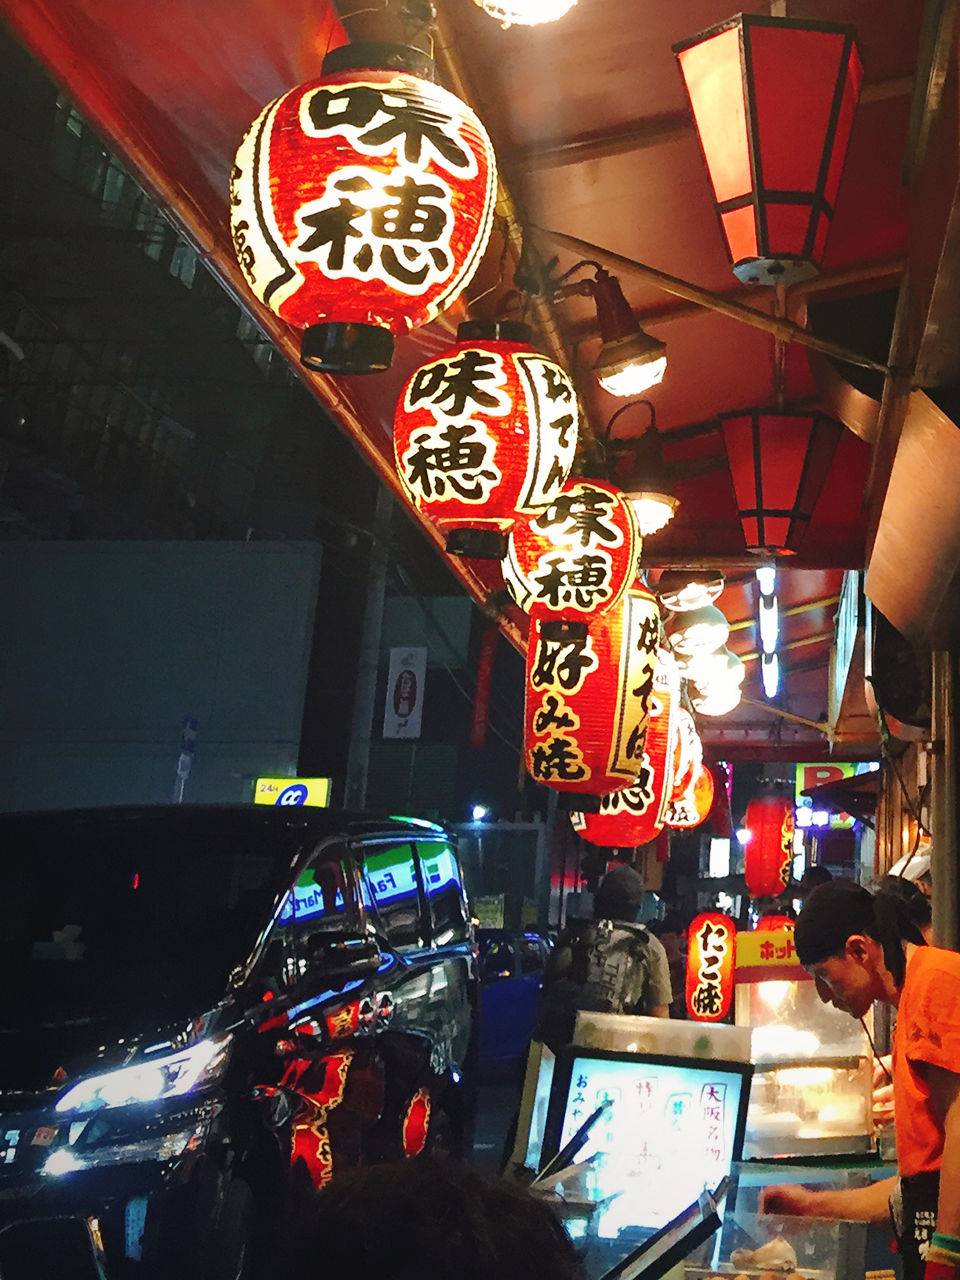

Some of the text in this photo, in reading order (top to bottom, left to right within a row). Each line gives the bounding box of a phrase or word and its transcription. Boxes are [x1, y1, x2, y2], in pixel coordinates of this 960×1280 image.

[298, 85, 470, 286] 味穂
[407, 351, 501, 500] 味穂
[535, 485, 618, 608] 味穂
[531, 638, 594, 780] 好み焼
[693, 922, 725, 1015] たこ焼
